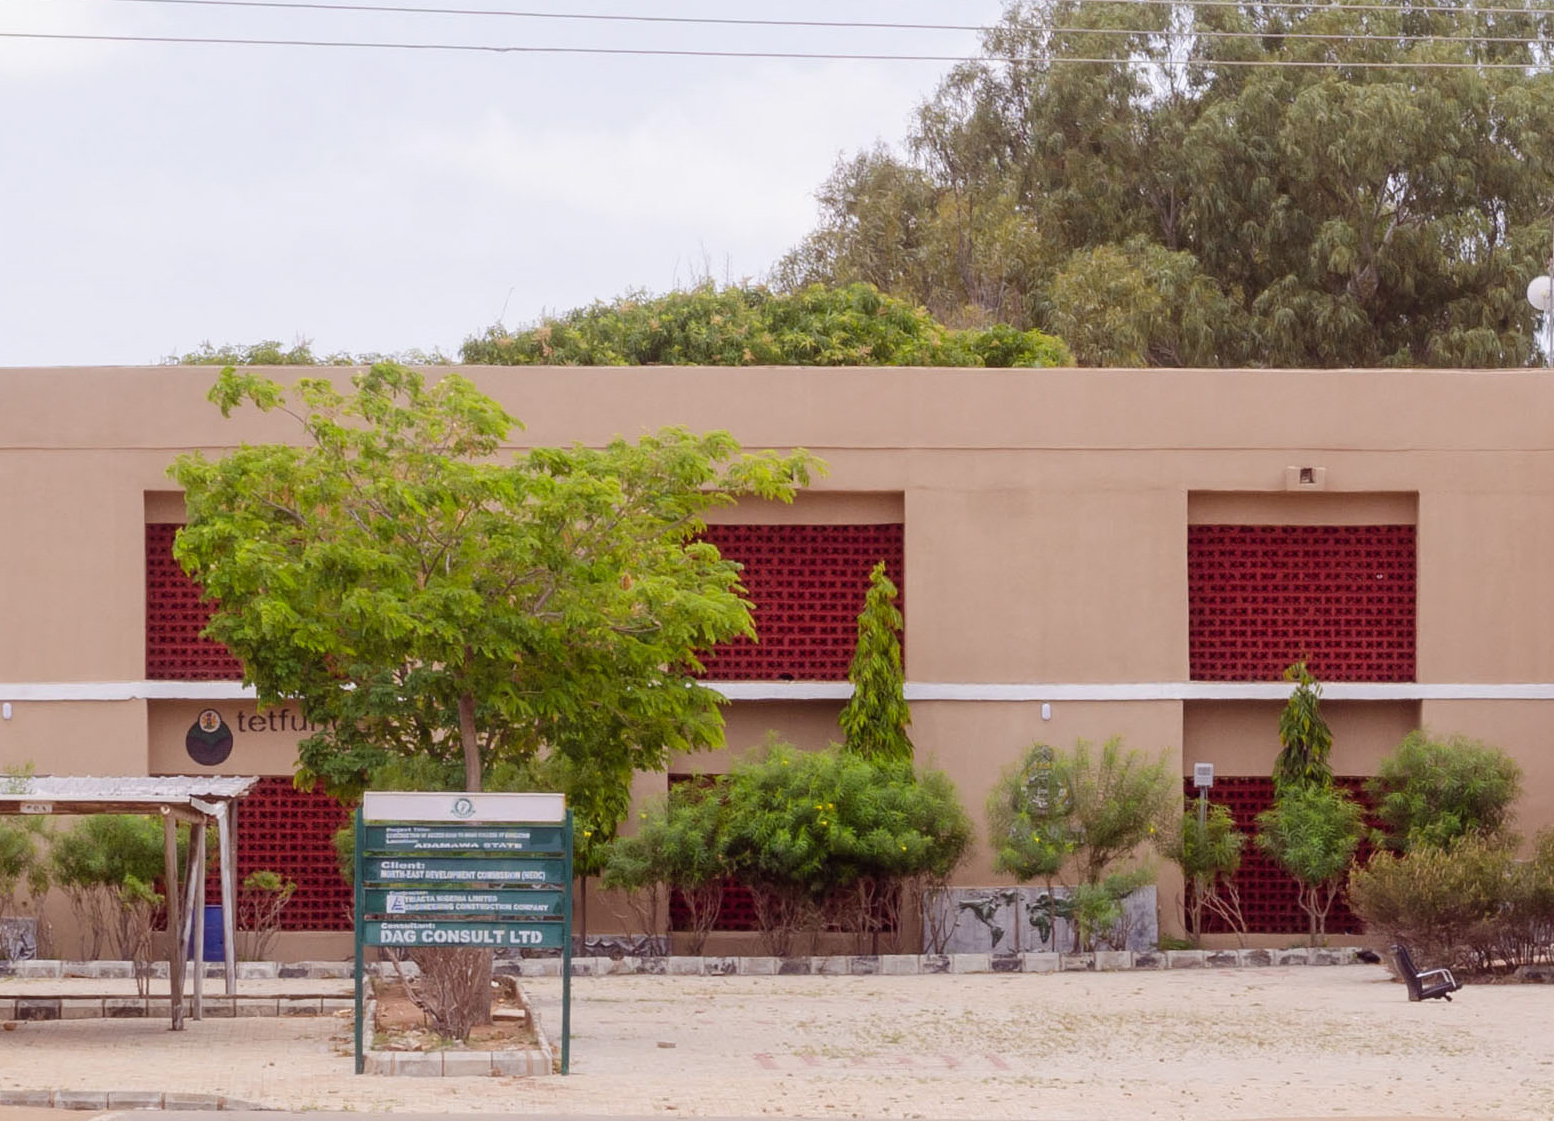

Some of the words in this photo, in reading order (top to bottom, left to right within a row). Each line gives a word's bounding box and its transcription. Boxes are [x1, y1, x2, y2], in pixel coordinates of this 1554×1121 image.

[237, 709, 338, 732] tetfu
[380, 861, 425, 869] Client:
[380, 870, 425, 878] NORTH-EAST
[425, 870, 476, 879] DEVELOPMENT
[477, 871, 521, 880] COMMISSION
[380, 929, 416, 943] DAG
[421, 930, 505, 944] CONSULT
[509, 930, 543, 944] LTD
